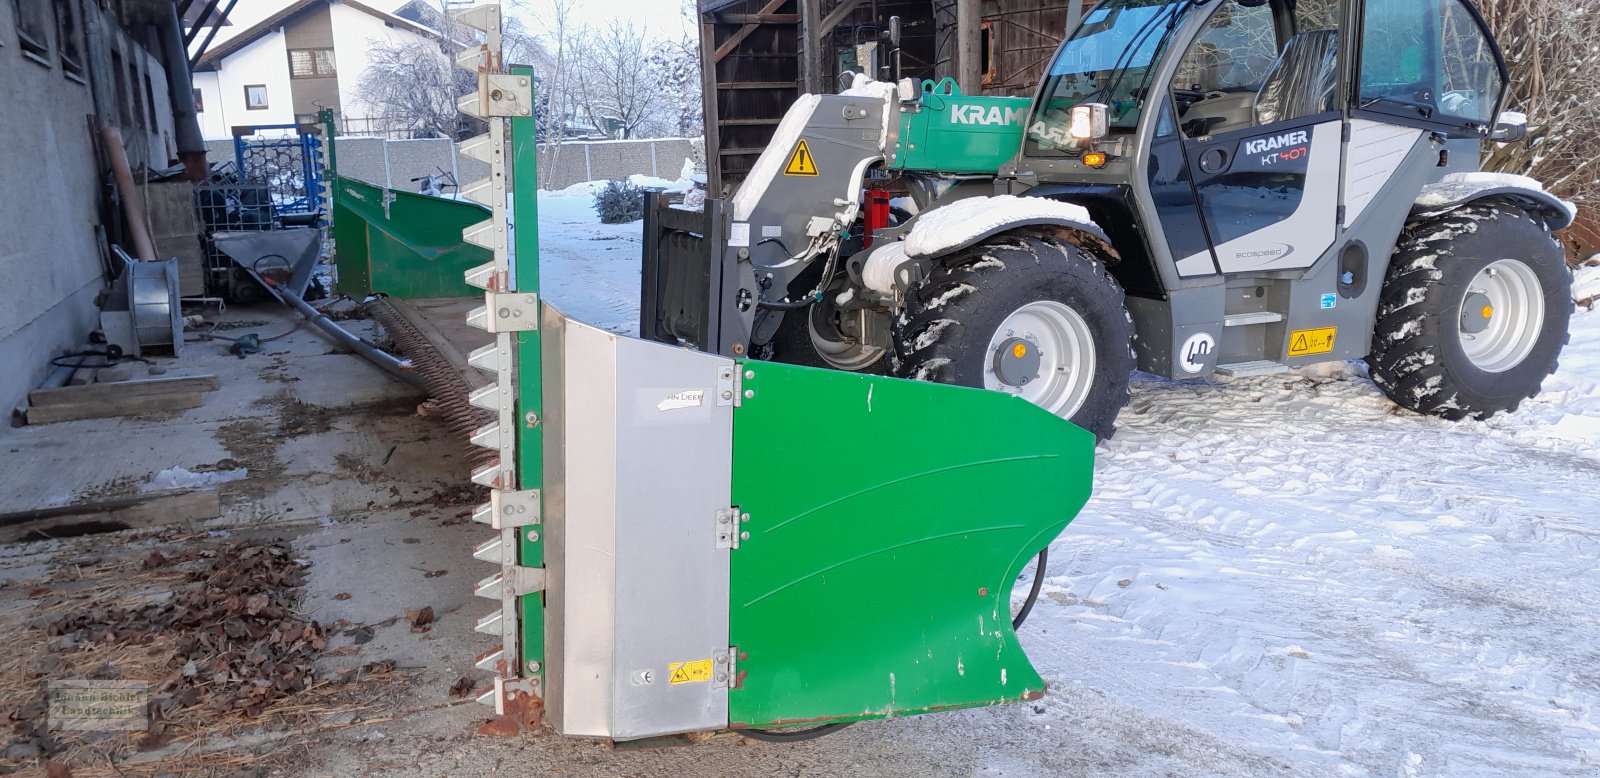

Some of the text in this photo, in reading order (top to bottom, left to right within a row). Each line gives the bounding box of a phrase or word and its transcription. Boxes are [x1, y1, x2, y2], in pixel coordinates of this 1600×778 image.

[951, 104, 1030, 126] KRAM
[1246, 130, 1308, 155] KRAMER
[1235, 249, 1282, 259] ecospeed
